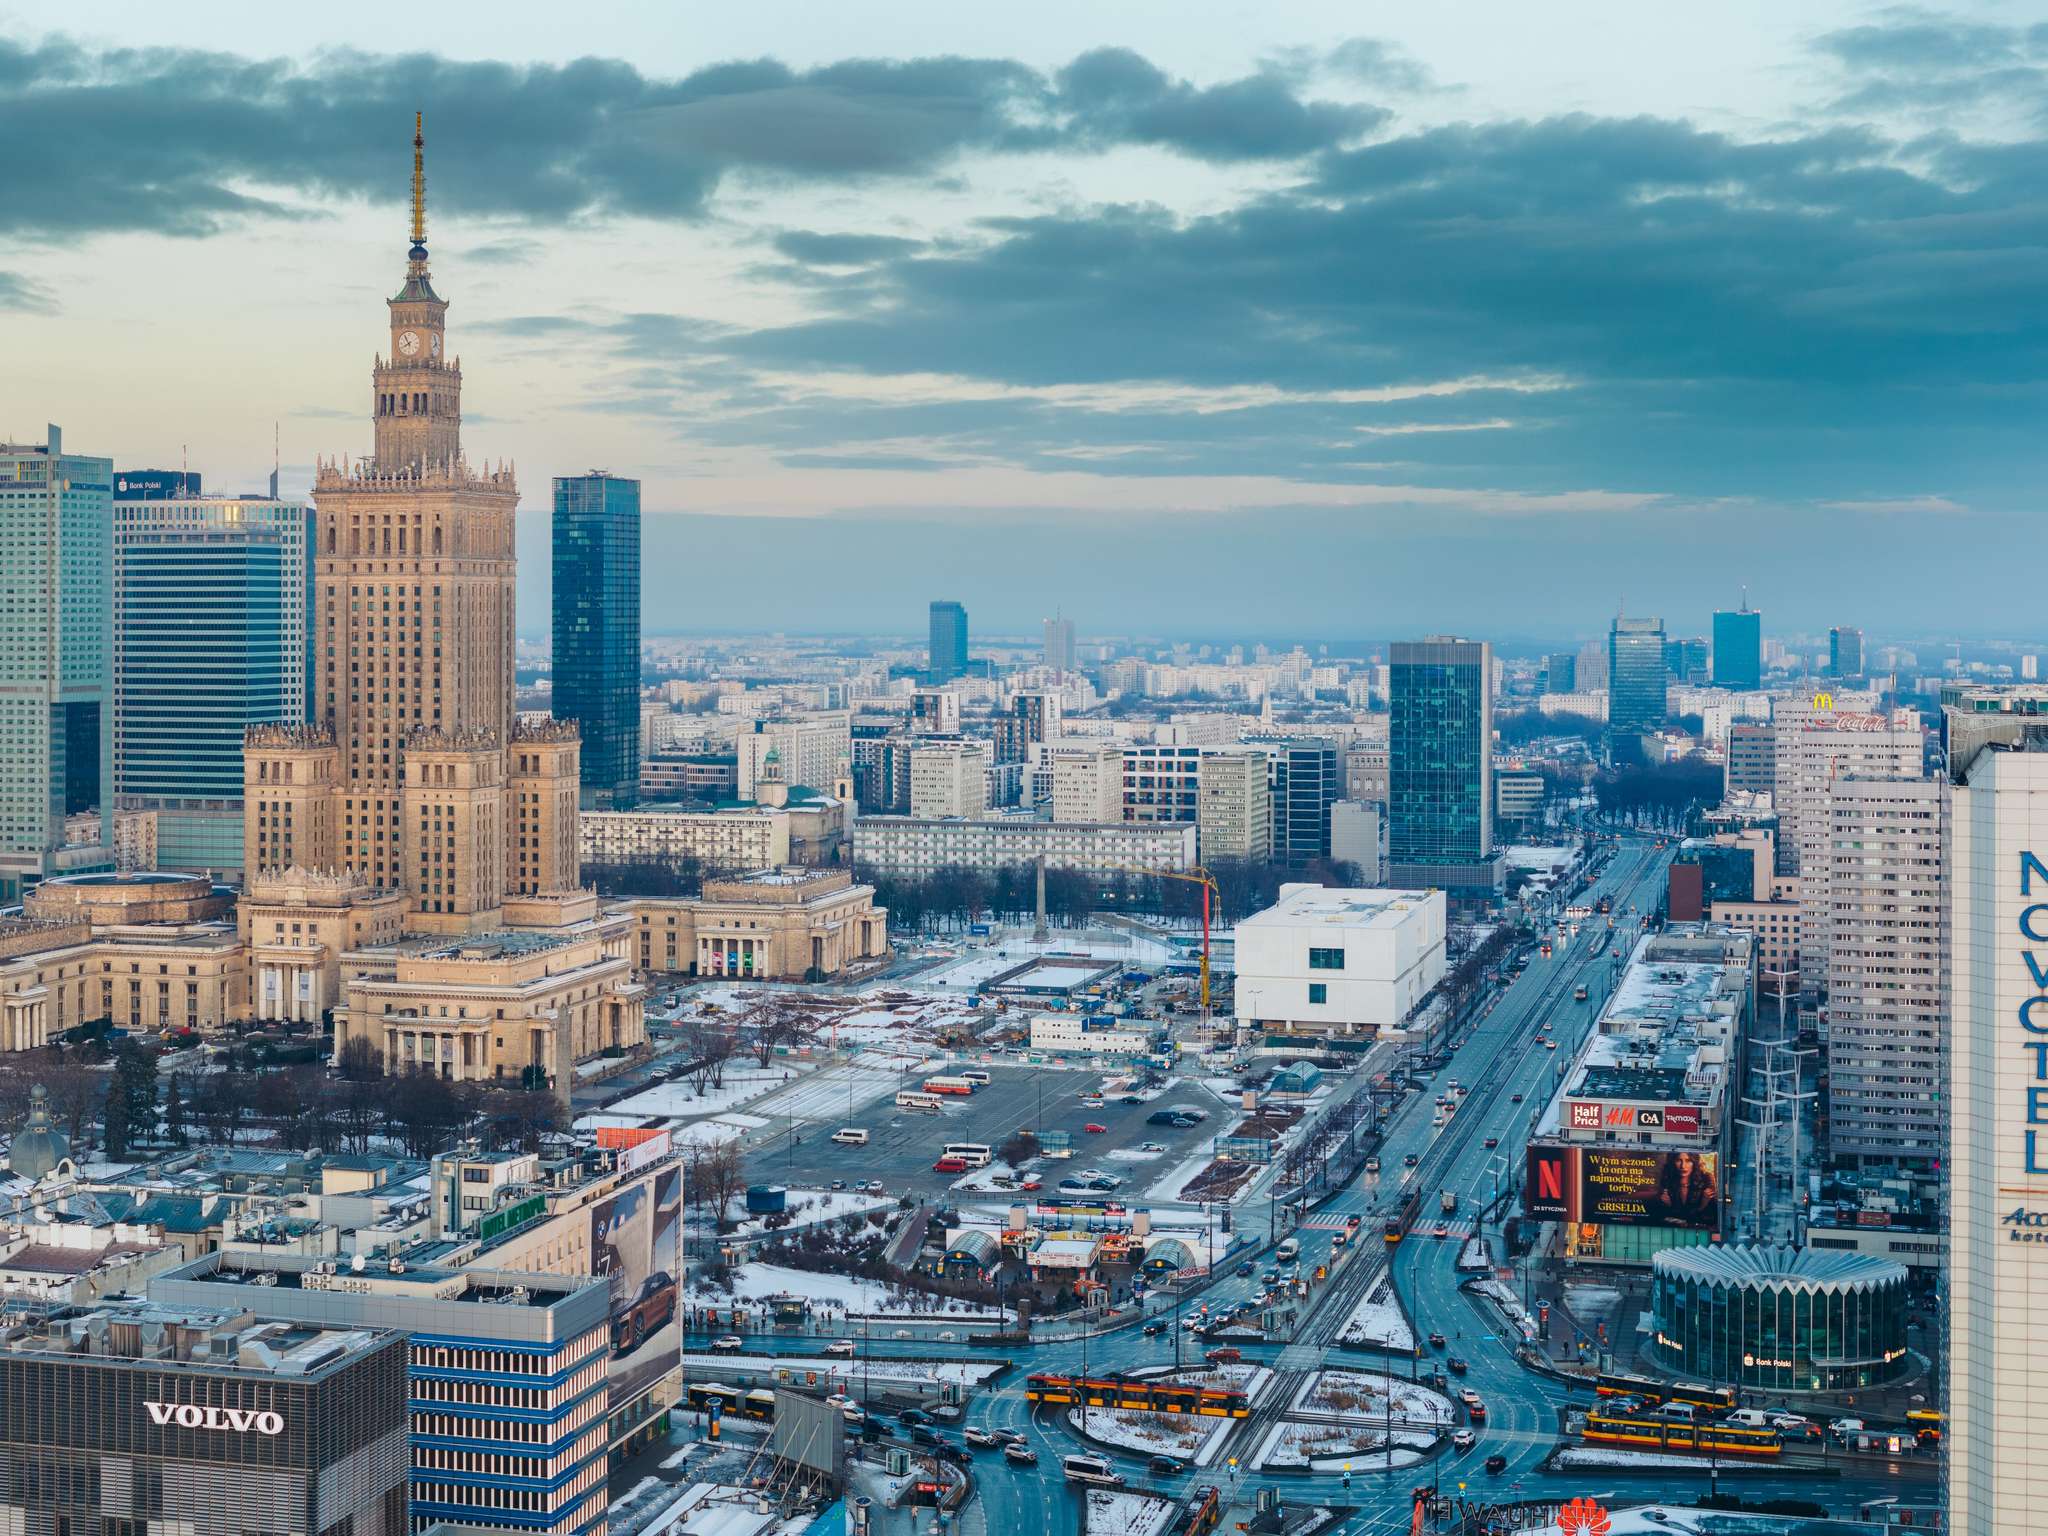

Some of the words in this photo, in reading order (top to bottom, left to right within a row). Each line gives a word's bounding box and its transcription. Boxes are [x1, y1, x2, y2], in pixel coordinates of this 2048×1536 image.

[1574, 1105, 1599, 1117] Half
[1574, 1116, 1599, 1126] Price
[1589, 1155, 1600, 1164] W
[1602, 1157, 1619, 1166] tym
[1621, 1157, 1656, 1167] sezonie
[1589, 1175, 1655, 1185] najmodniejsze
[1609, 1184, 1636, 1194] torby.
[1598, 1202, 1646, 1213] GRISELDA
[1755, 1358, 1772, 1366] Bank
[1773, 1359, 1792, 1367] Polski
[142, 1401, 285, 1435] VOLVO
